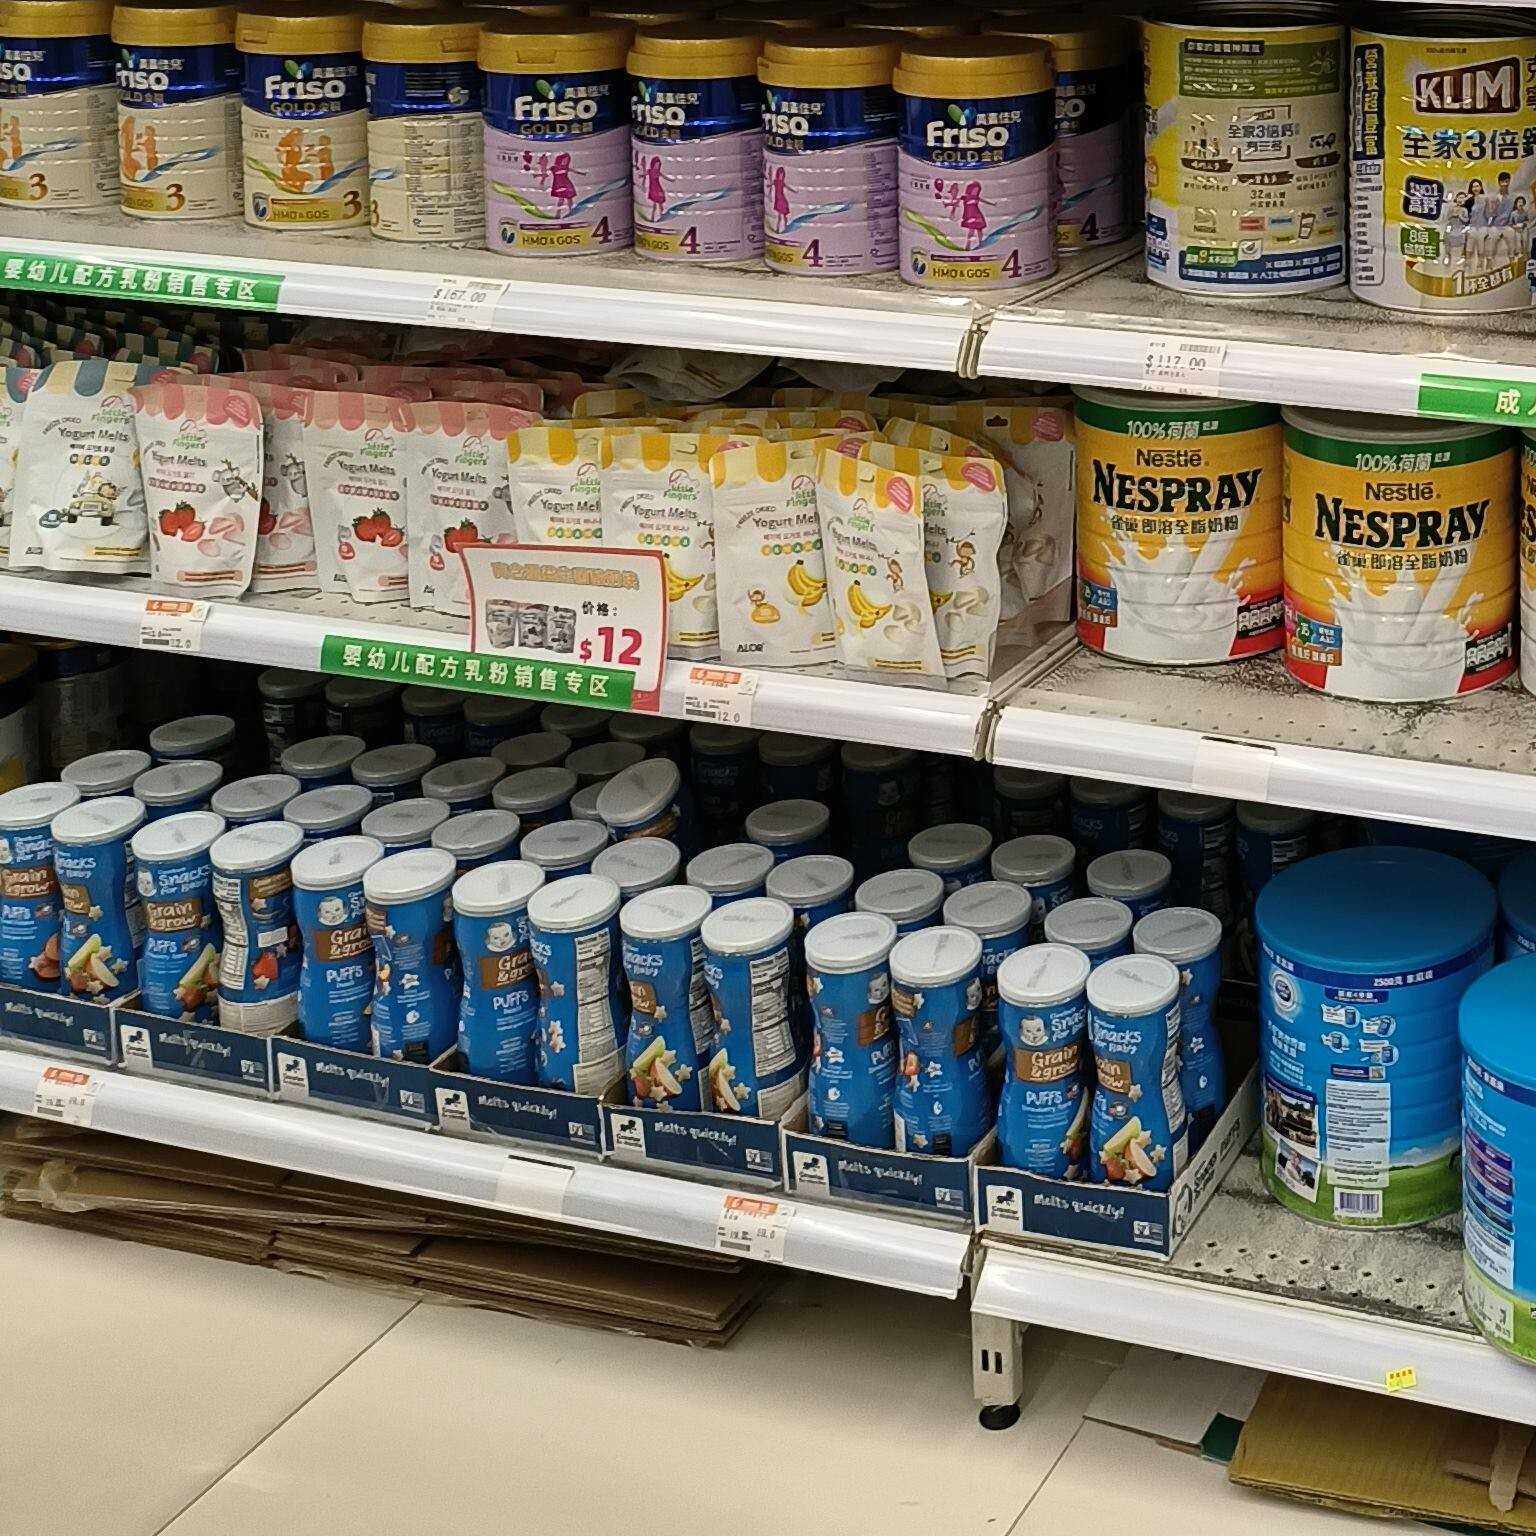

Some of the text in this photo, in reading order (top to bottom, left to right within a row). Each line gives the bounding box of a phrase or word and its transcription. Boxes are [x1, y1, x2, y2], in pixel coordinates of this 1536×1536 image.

[265, 75, 346, 101] Friso
[1420, 66, 1513, 112] KLIM
[515, 94, 598, 122] Friso
[926, 120, 1010, 149] Friso
[29, 174, 49, 202] 3
[166, 184, 186, 212] 3
[343, 191, 363, 219] 3
[592, 217, 612, 245] 4
[680, 227, 701, 255] 4
[1081, 213, 1100, 241] 4
[803, 240, 824, 269] 4
[1001, 250, 1022, 279] 4
[3, 257, 256, 302] 婴幼儿配方乳粉销售专区
[1136, 447, 1202, 468] Nestlé
[1092, 460, 1263, 513] NESPRAY
[1365, 480, 1434, 501] Nestlé
[1314, 492, 1491, 548] NESPRAY
[579, 627, 642, 666] $12
[342, 644, 610, 698] 婴幼儿配方乳粉销售专区
